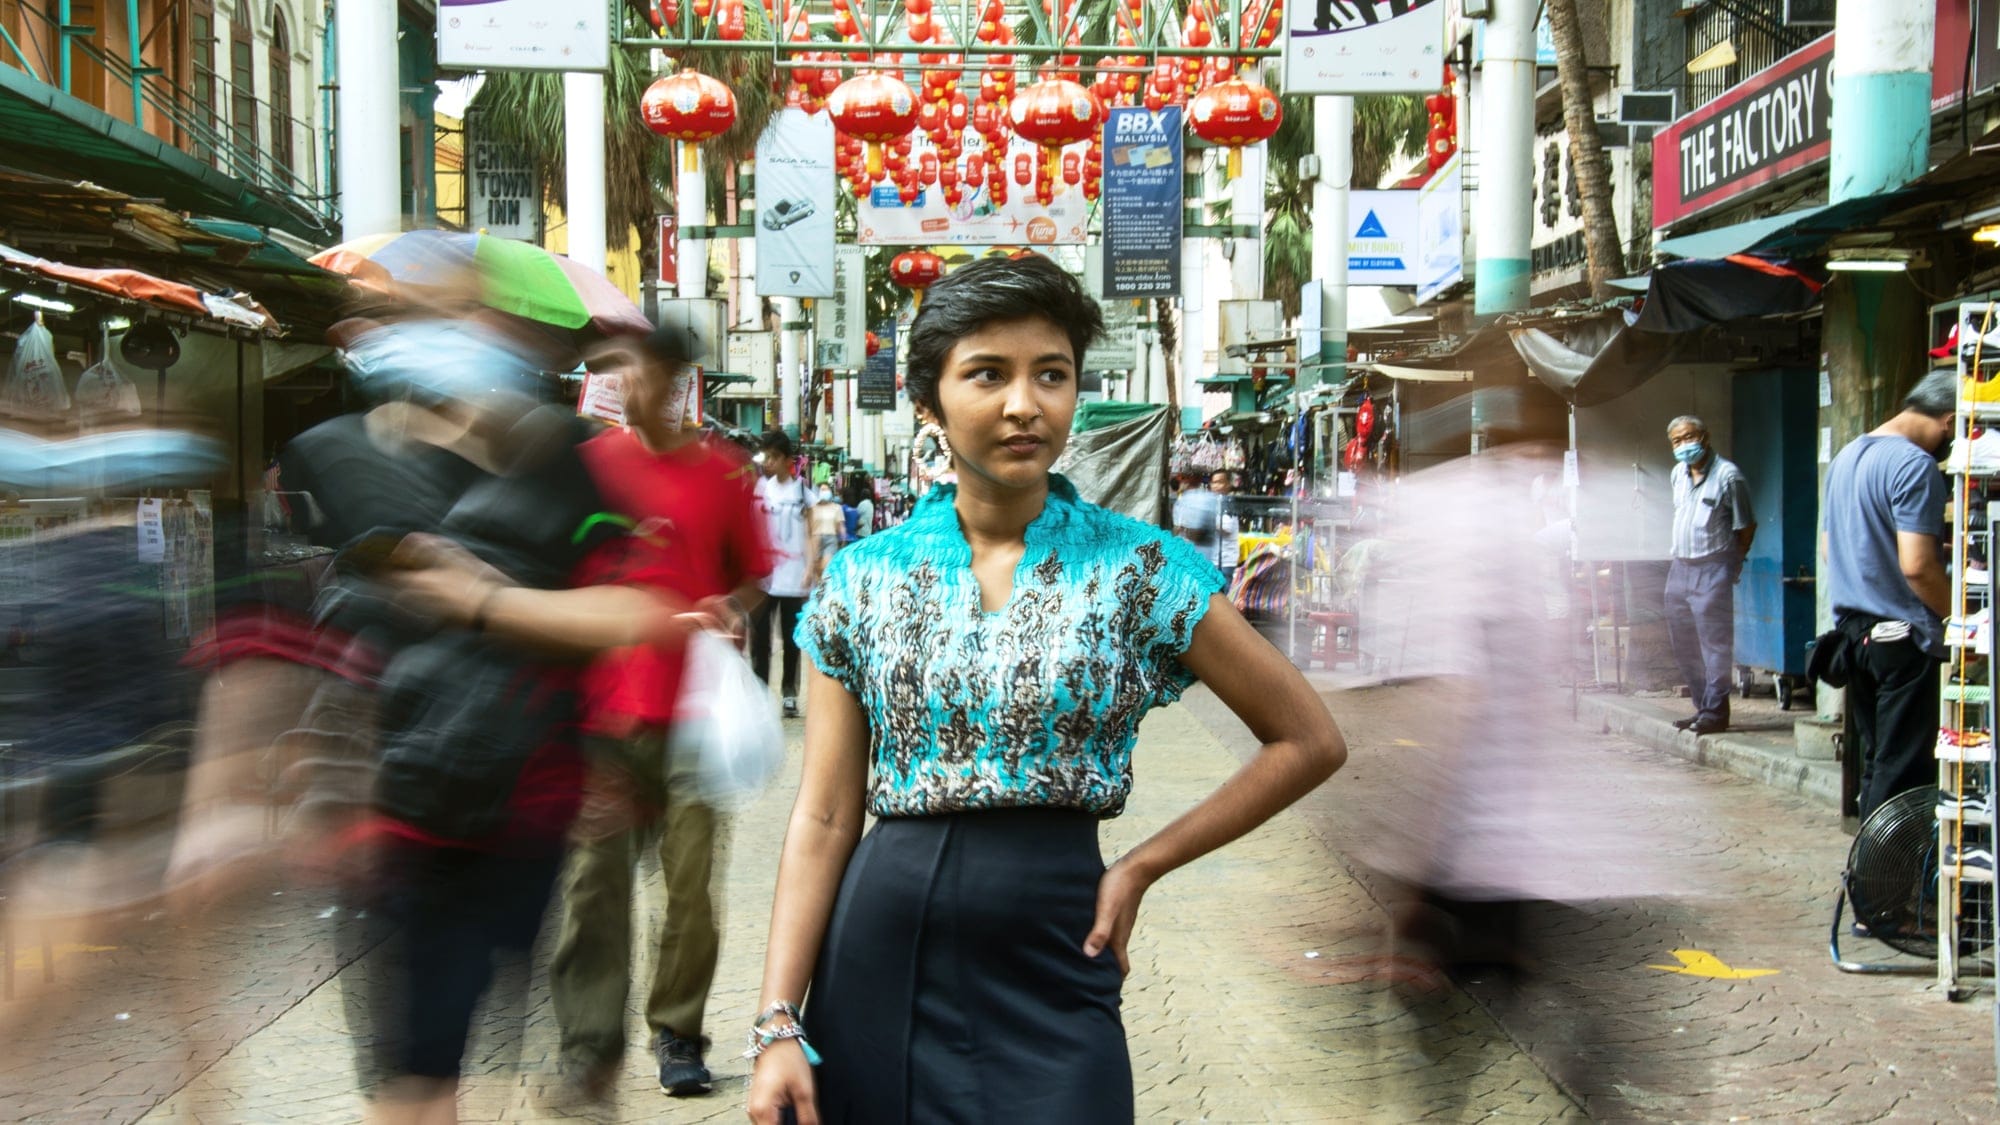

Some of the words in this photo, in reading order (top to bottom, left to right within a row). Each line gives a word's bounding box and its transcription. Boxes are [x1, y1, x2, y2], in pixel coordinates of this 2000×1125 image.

[1116, 112, 1168, 134] BBX
[1680, 123, 1716, 196] THE
[1720, 68, 1818, 178] FACTORY
[1115, 134, 1168, 143] MALAYSIA
[475, 144, 533, 169] CHINA
[476, 171, 532, 198] TOWN
[488, 199, 520, 226] INN
[1371, 241, 1407, 253] BUNDLE
[1116, 283, 1136, 291] 1800
